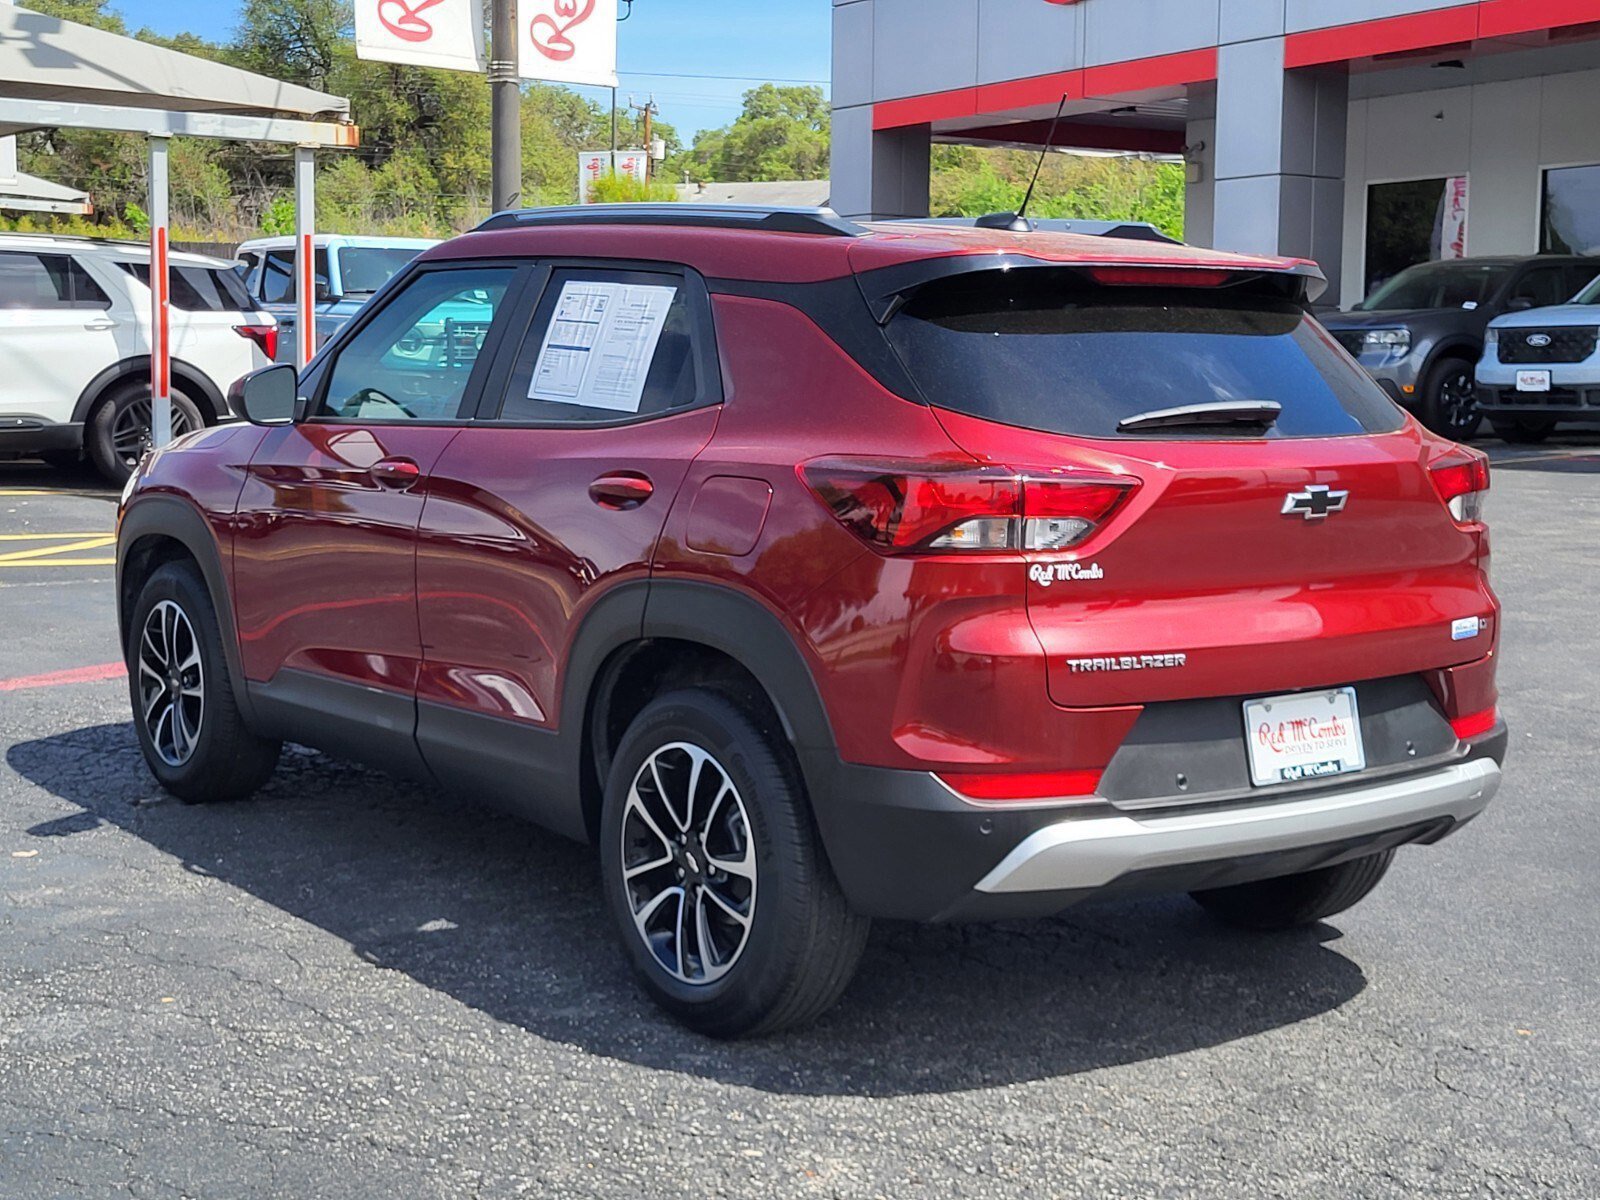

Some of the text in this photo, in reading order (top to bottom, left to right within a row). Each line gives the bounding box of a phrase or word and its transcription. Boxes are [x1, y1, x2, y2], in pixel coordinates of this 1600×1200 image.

[1029, 562, 1104, 587] Red McCombs
[1066, 653, 1187, 672] TRAILBLAZER
[1258, 716, 1346, 753] Red McCombs
[1314, 740, 1325, 750] TO
